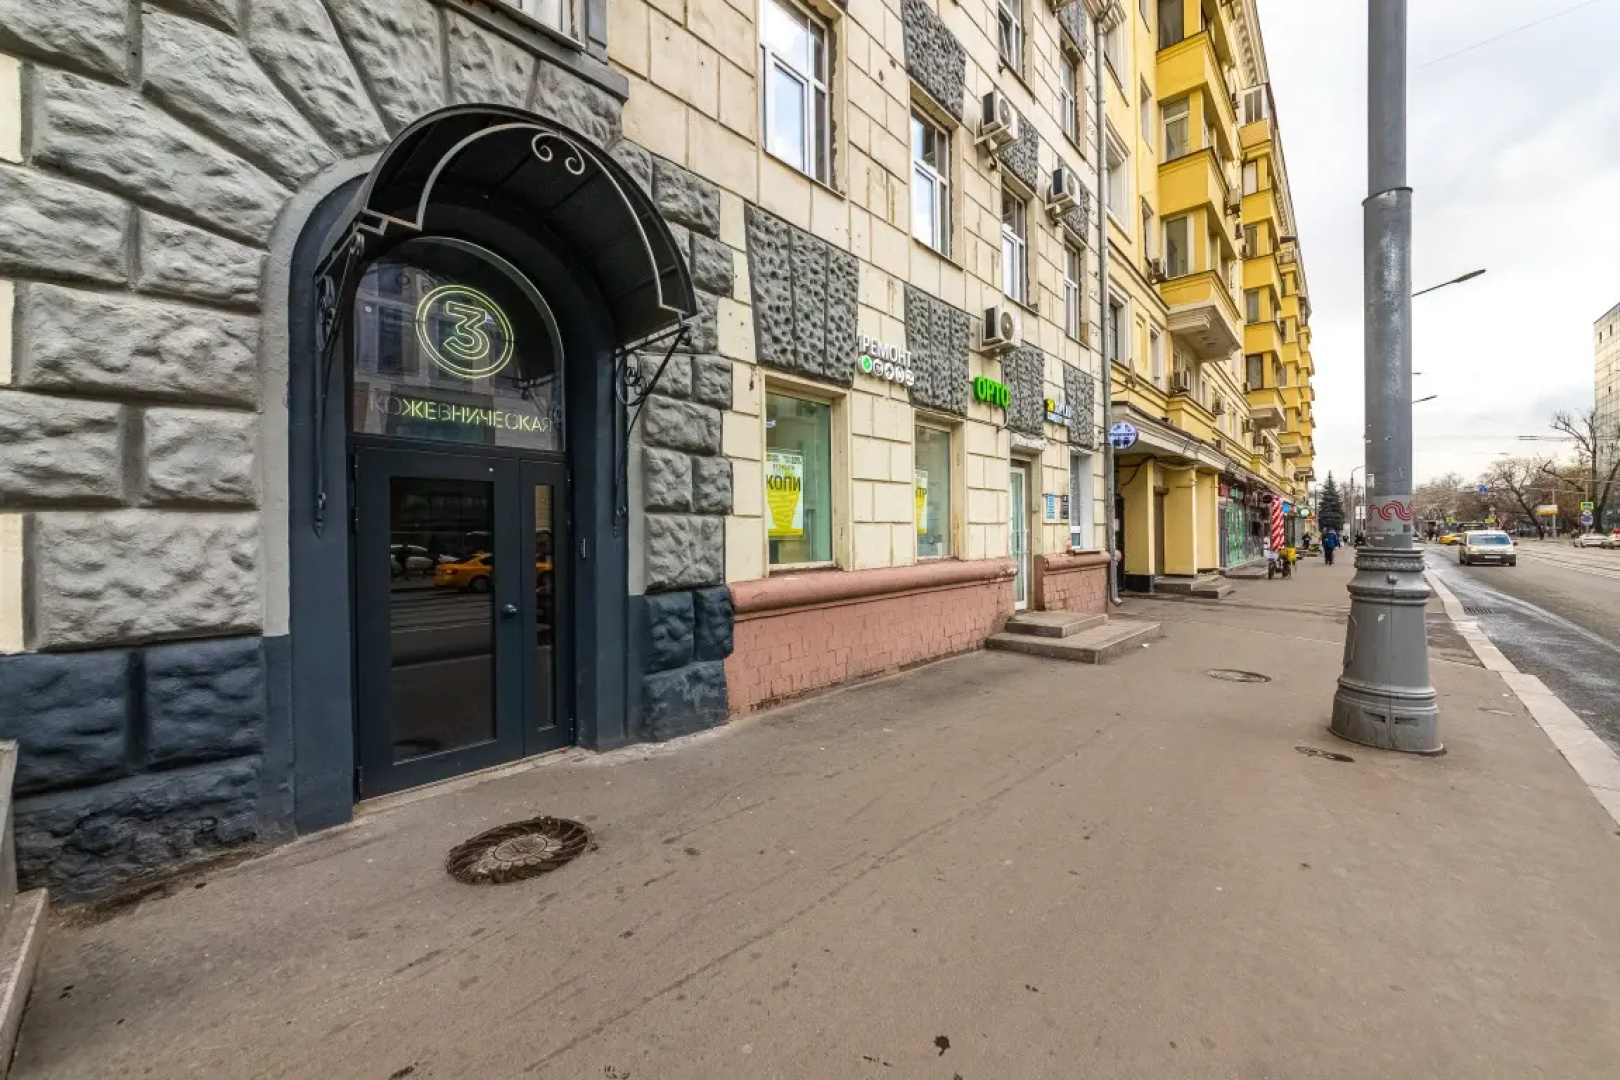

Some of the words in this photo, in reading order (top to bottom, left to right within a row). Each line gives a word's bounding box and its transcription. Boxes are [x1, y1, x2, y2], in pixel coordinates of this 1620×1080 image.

[443, 301, 490, 359] 3
[862, 334, 911, 368] РЕМОНТ
[976, 377, 1009, 407] ОРТО
[370, 395, 552, 432] КОЖЕВНИЧЕСКАЯ
[766, 474, 801, 491] КОПИ
